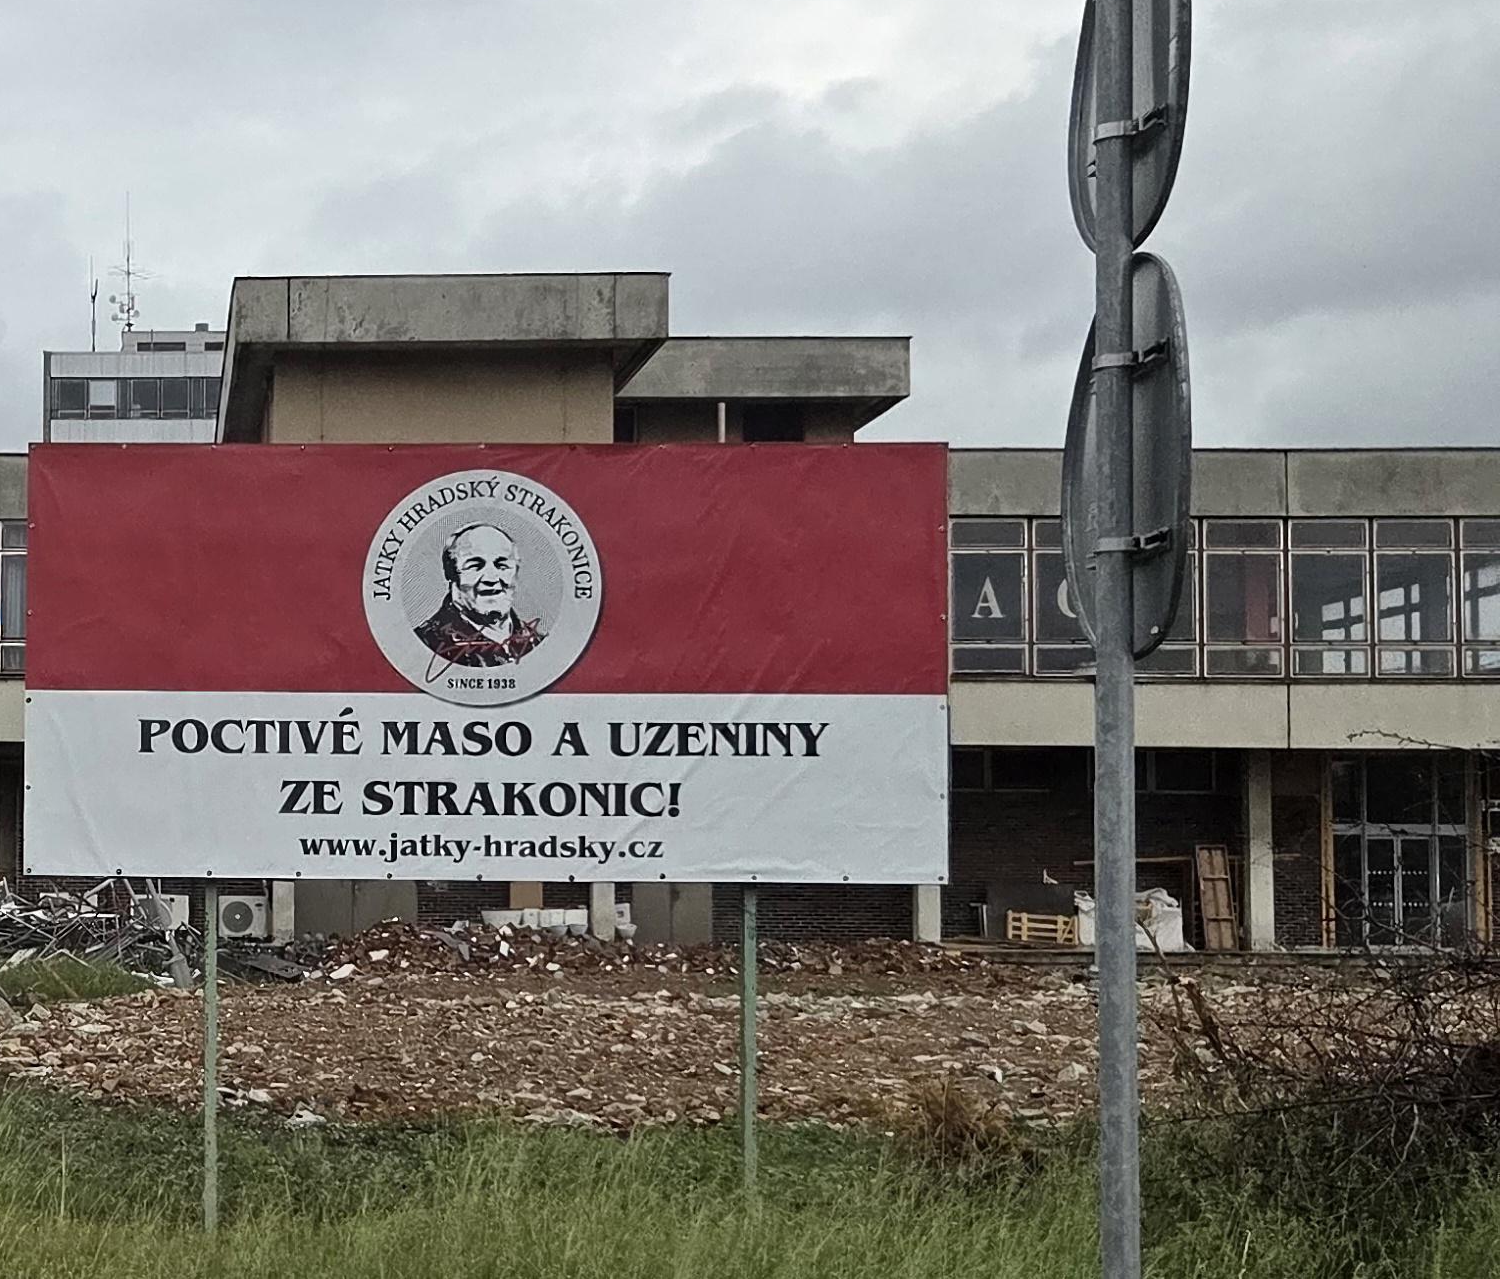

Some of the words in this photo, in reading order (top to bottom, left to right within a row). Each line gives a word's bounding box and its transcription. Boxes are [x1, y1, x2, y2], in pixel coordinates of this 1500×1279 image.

[372, 528, 405, 601] JATKY
[396, 476, 501, 534] HRADSKÝ
[504, 484, 594, 600] STRAKONICE
[446, 678, 485, 690] SINCE
[486, 678, 516, 690] 1938
[138, 706, 363, 755] POCTIVÉ
[380, 720, 532, 757] MASO
[550, 721, 590, 757] A
[606, 721, 830, 757] UZENINY
[278, 779, 344, 815] ZE
[361, 780, 682, 818] STRAKONIC!
[298, 832, 665, 865] www.jatky-hradsky.cz
